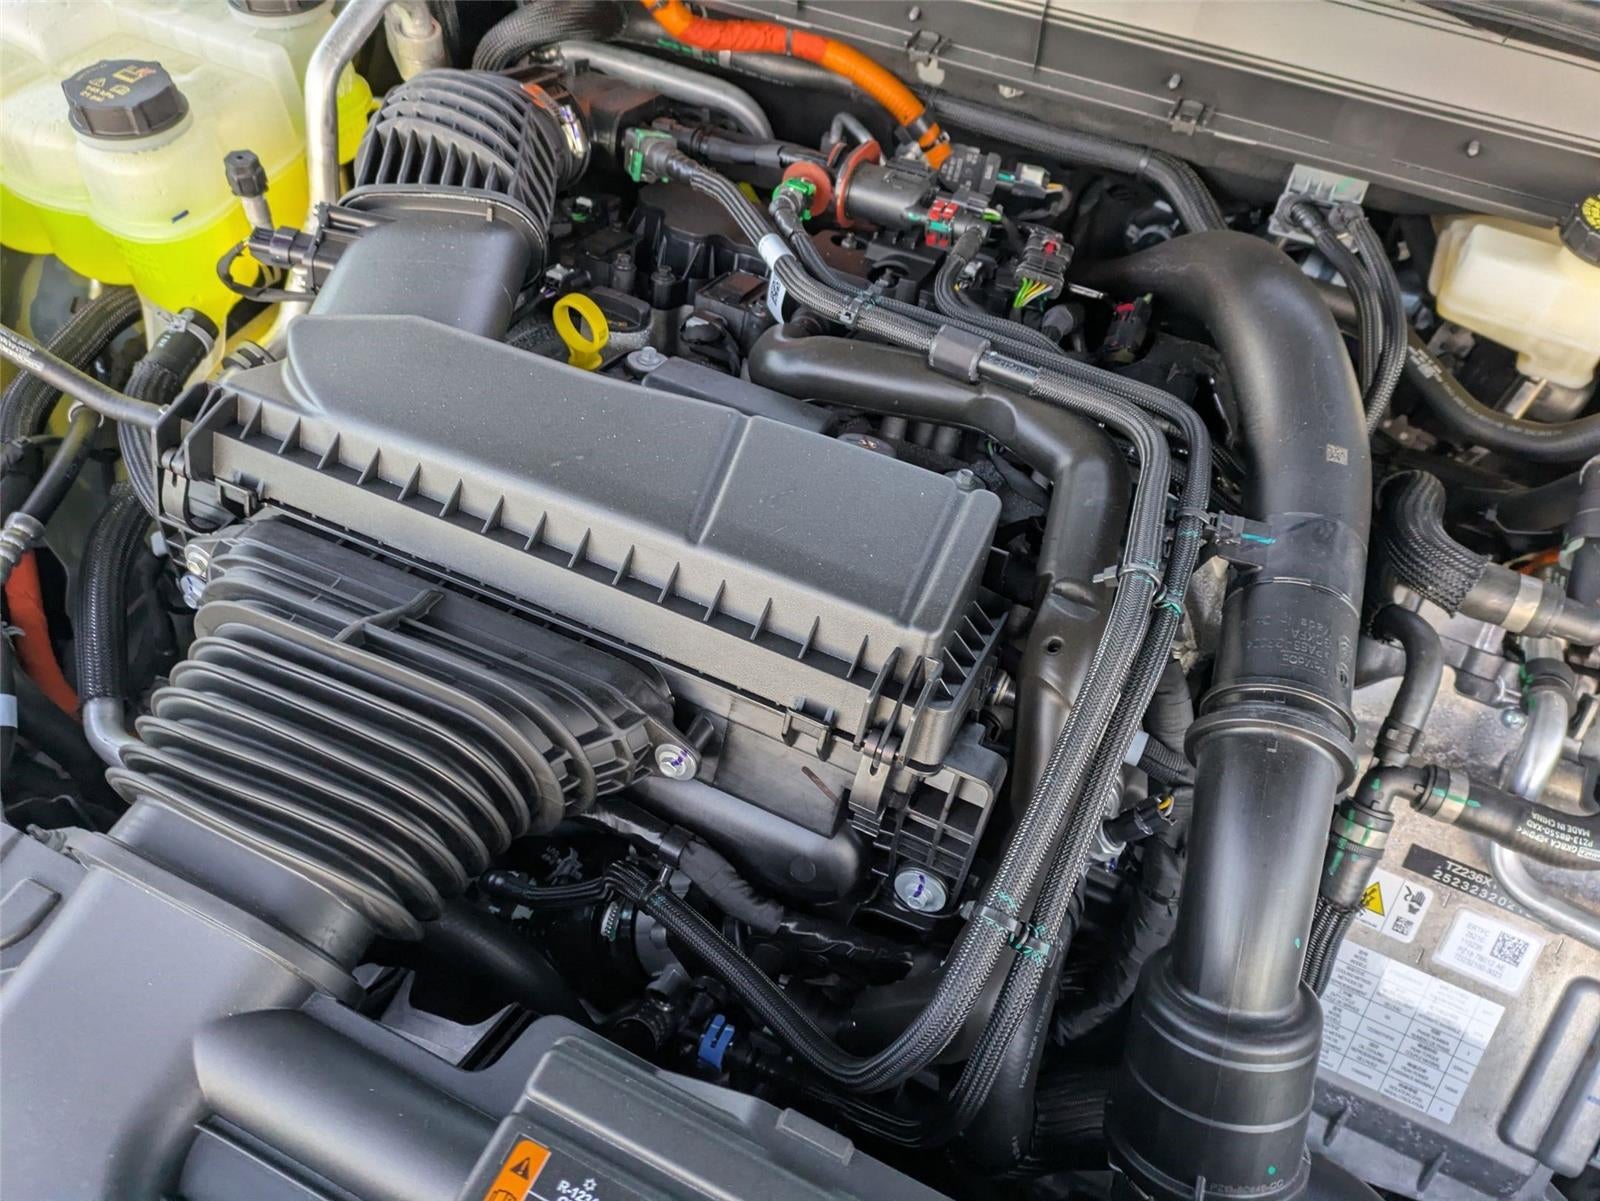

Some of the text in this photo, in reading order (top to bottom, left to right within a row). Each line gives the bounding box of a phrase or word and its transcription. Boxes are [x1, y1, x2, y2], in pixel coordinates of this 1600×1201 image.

[1531, 811, 1591, 838] MADE IN CHINA
